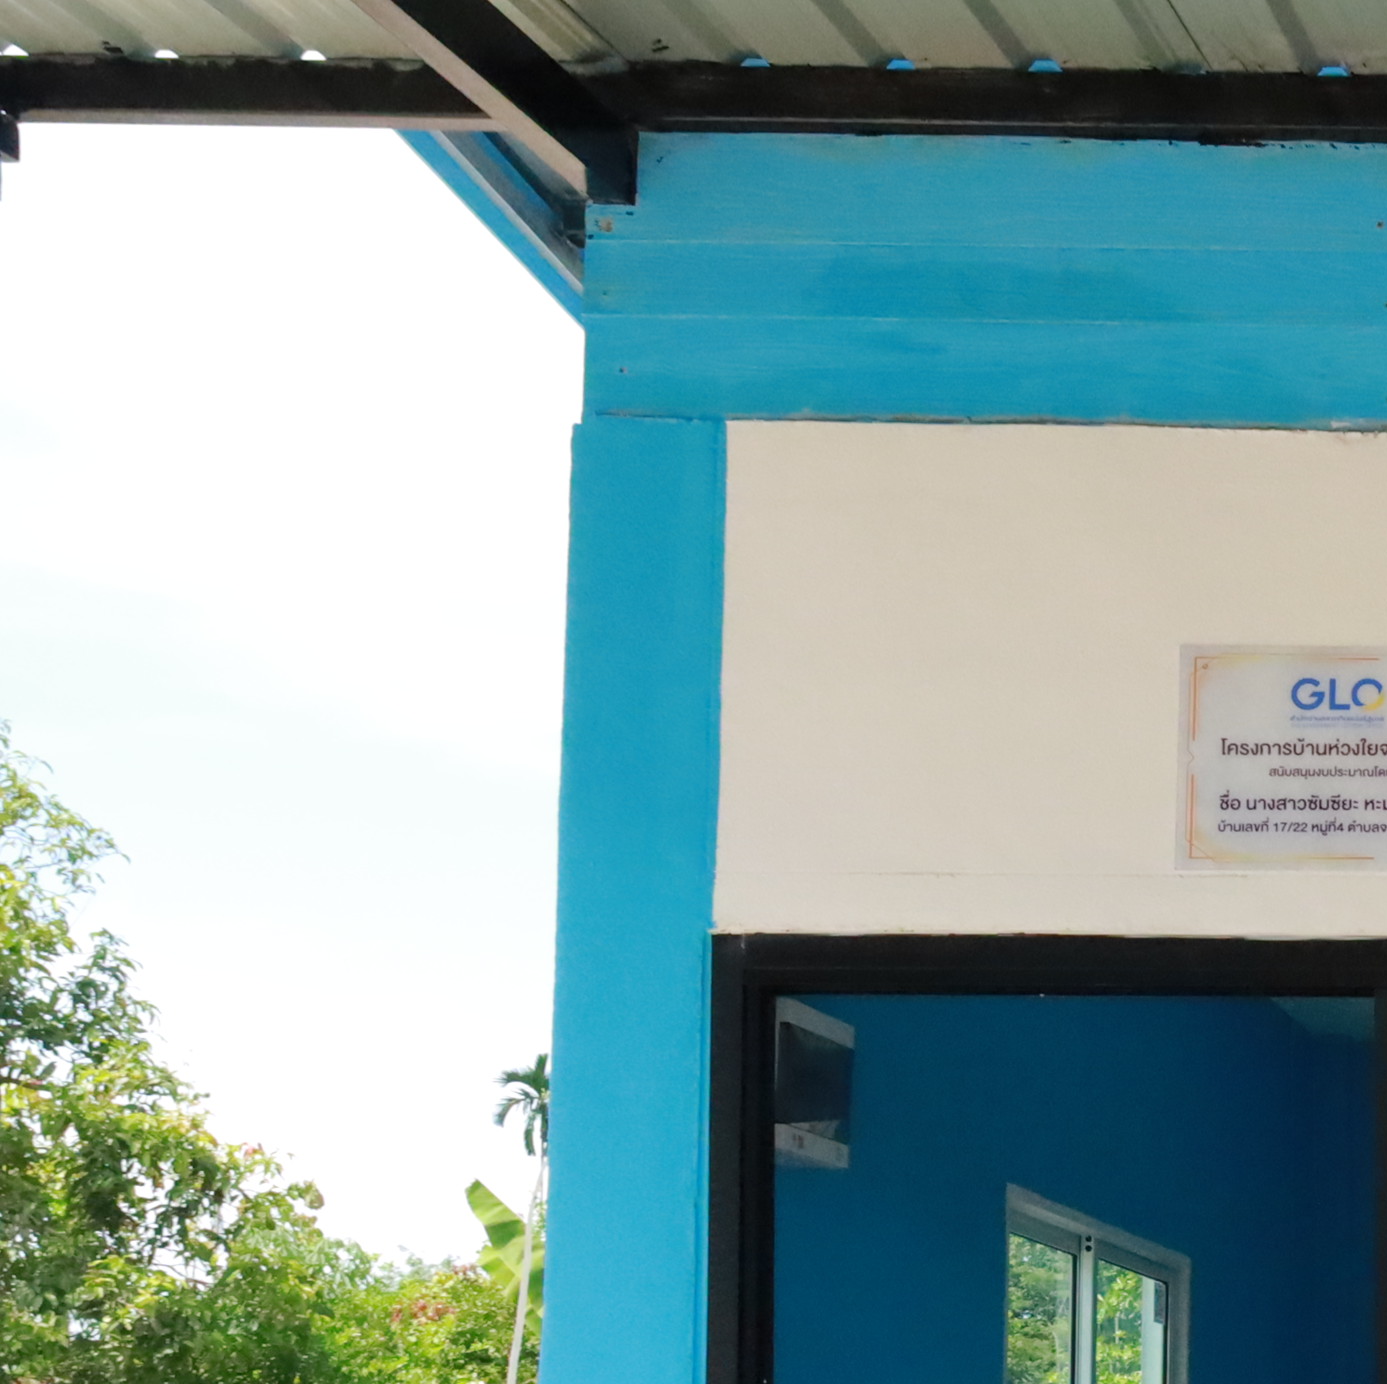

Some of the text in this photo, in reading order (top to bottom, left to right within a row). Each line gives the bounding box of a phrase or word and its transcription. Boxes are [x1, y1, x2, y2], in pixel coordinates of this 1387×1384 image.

[1290, 677, 1385, 711] GLO
[1219, 790, 1241, 811] ชื่อ
[1217, 817, 1269, 833] บ้านเลขที่
[1274, 822, 1308, 833] 17/22
